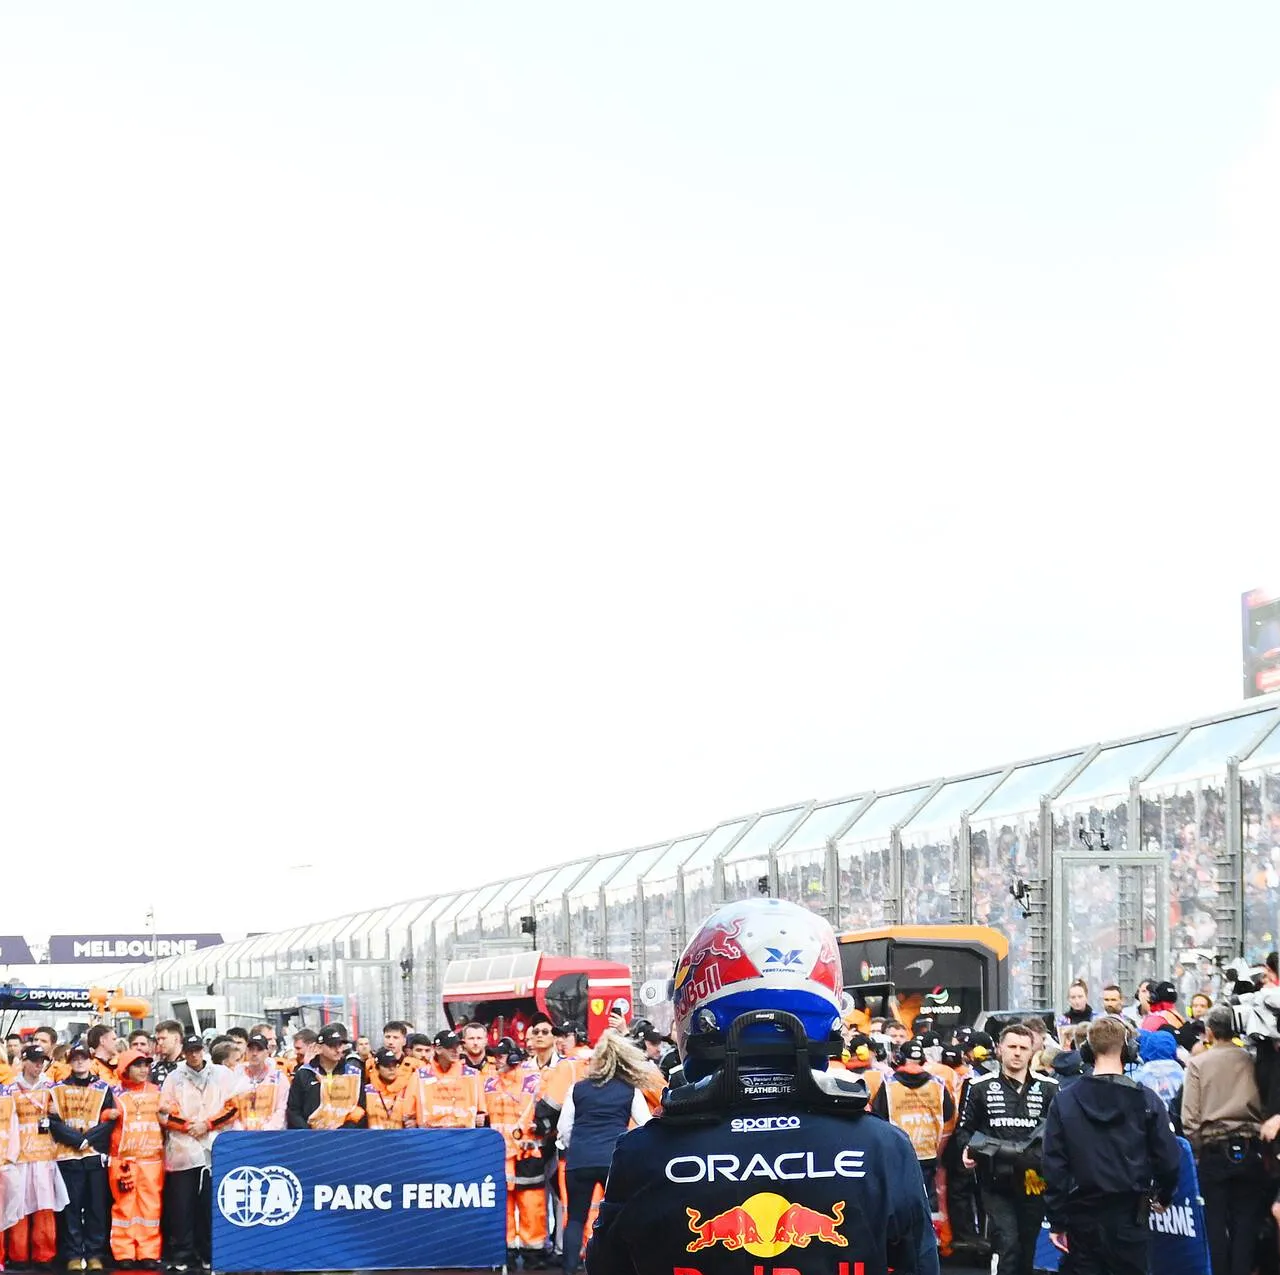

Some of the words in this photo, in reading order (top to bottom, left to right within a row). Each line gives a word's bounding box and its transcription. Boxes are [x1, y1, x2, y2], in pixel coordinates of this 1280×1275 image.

[73, 940, 197, 957] MELBOURNE
[744, 1086, 791, 1094] FEATHERLITE
[731, 1115, 800, 1132] sparco
[989, 1117, 1038, 1128] PETRONA
[665, 1150, 866, 1183] ORACLE
[314, 1183, 392, 1210] PARC
[402, 1175, 496, 1209] FERMÉ
